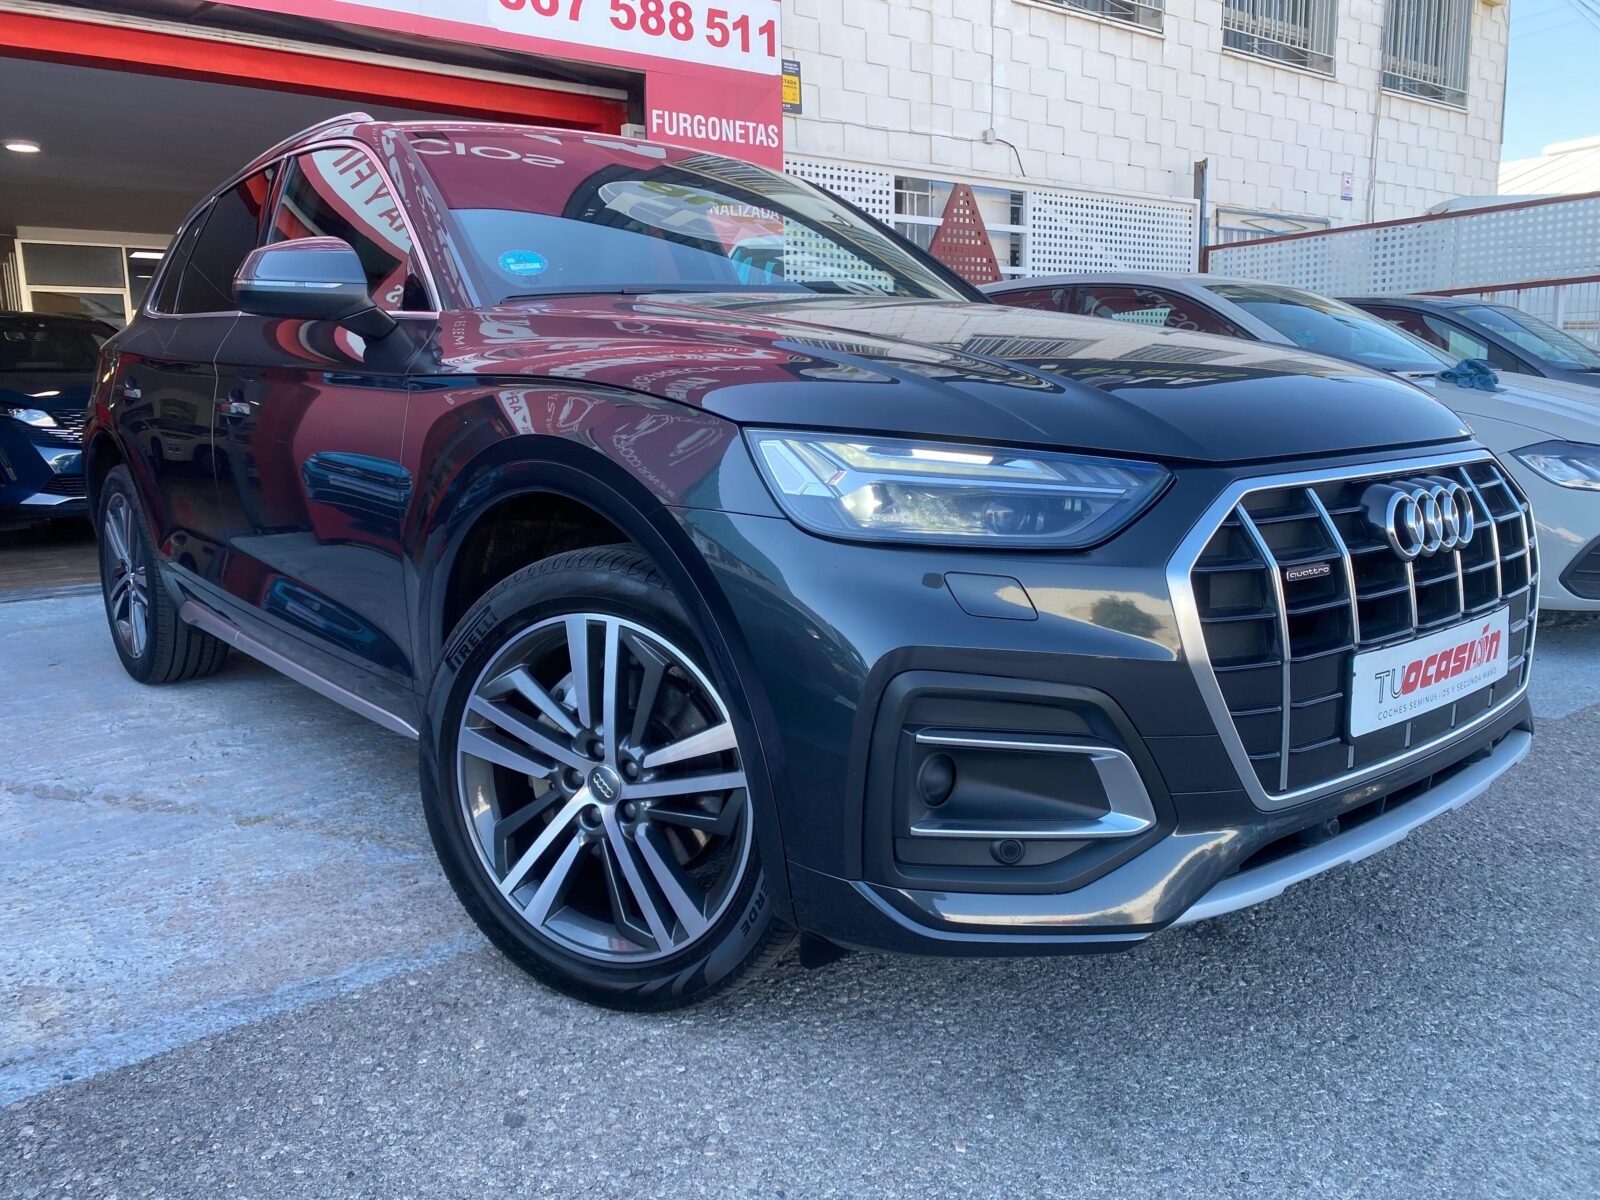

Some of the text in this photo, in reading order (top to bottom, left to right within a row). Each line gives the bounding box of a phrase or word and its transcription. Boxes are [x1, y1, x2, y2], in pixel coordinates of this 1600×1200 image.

[610, 0, 694, 41] 588
[706, 8, 775, 57] 511
[651, 109, 779, 148] FURGONETAS
[708, 204, 780, 220] NALIZADA
[1289, 566, 1329, 579] quattro
[444, 605, 498, 674] PIRELLI
[1378, 704, 1407, 720] COCHES
